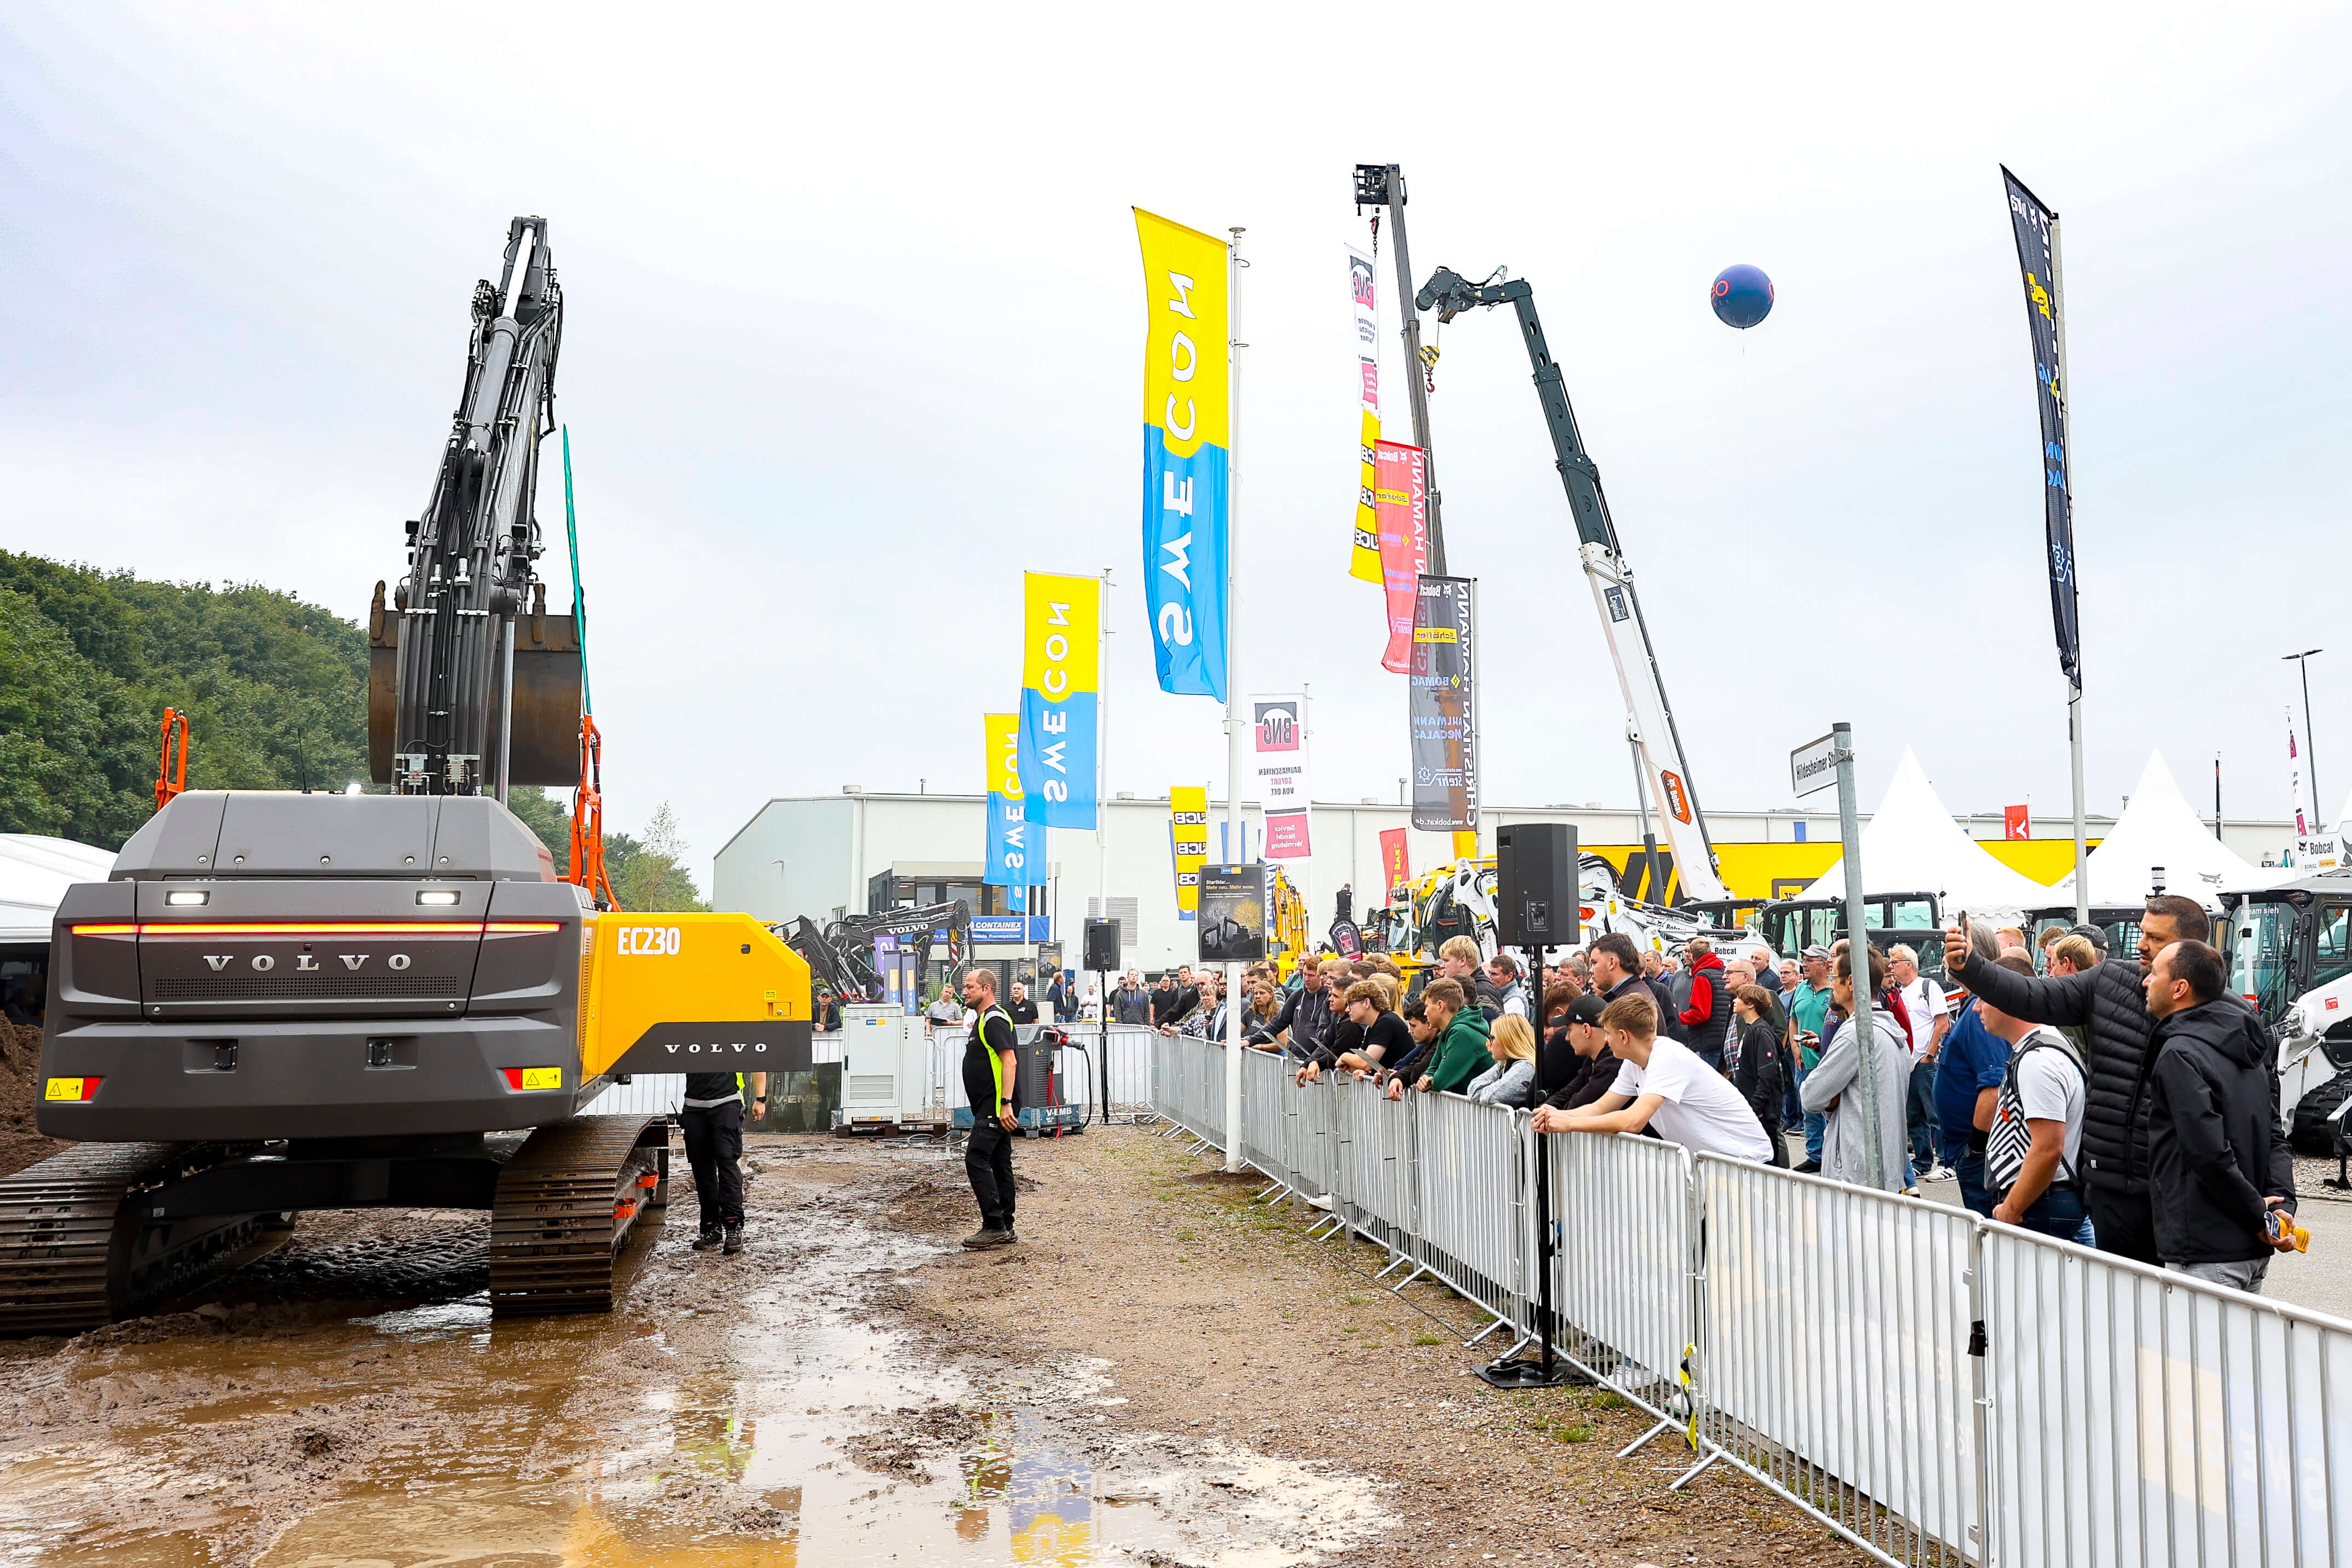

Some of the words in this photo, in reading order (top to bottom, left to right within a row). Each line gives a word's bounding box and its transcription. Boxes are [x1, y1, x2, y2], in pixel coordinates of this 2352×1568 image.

[1796, 757, 1827, 781] Hildesheimer
[1669, 789, 1683, 815] Bobcat
[2310, 841, 2334, 855] Bobcat
[887, 923, 928, 935] VOLVO
[617, 926, 681, 956] EC230
[203, 954, 411, 972] VOLVO
[664, 1042, 767, 1054] VOLVO
[1046, 1107, 1072, 1116] V-EMB
